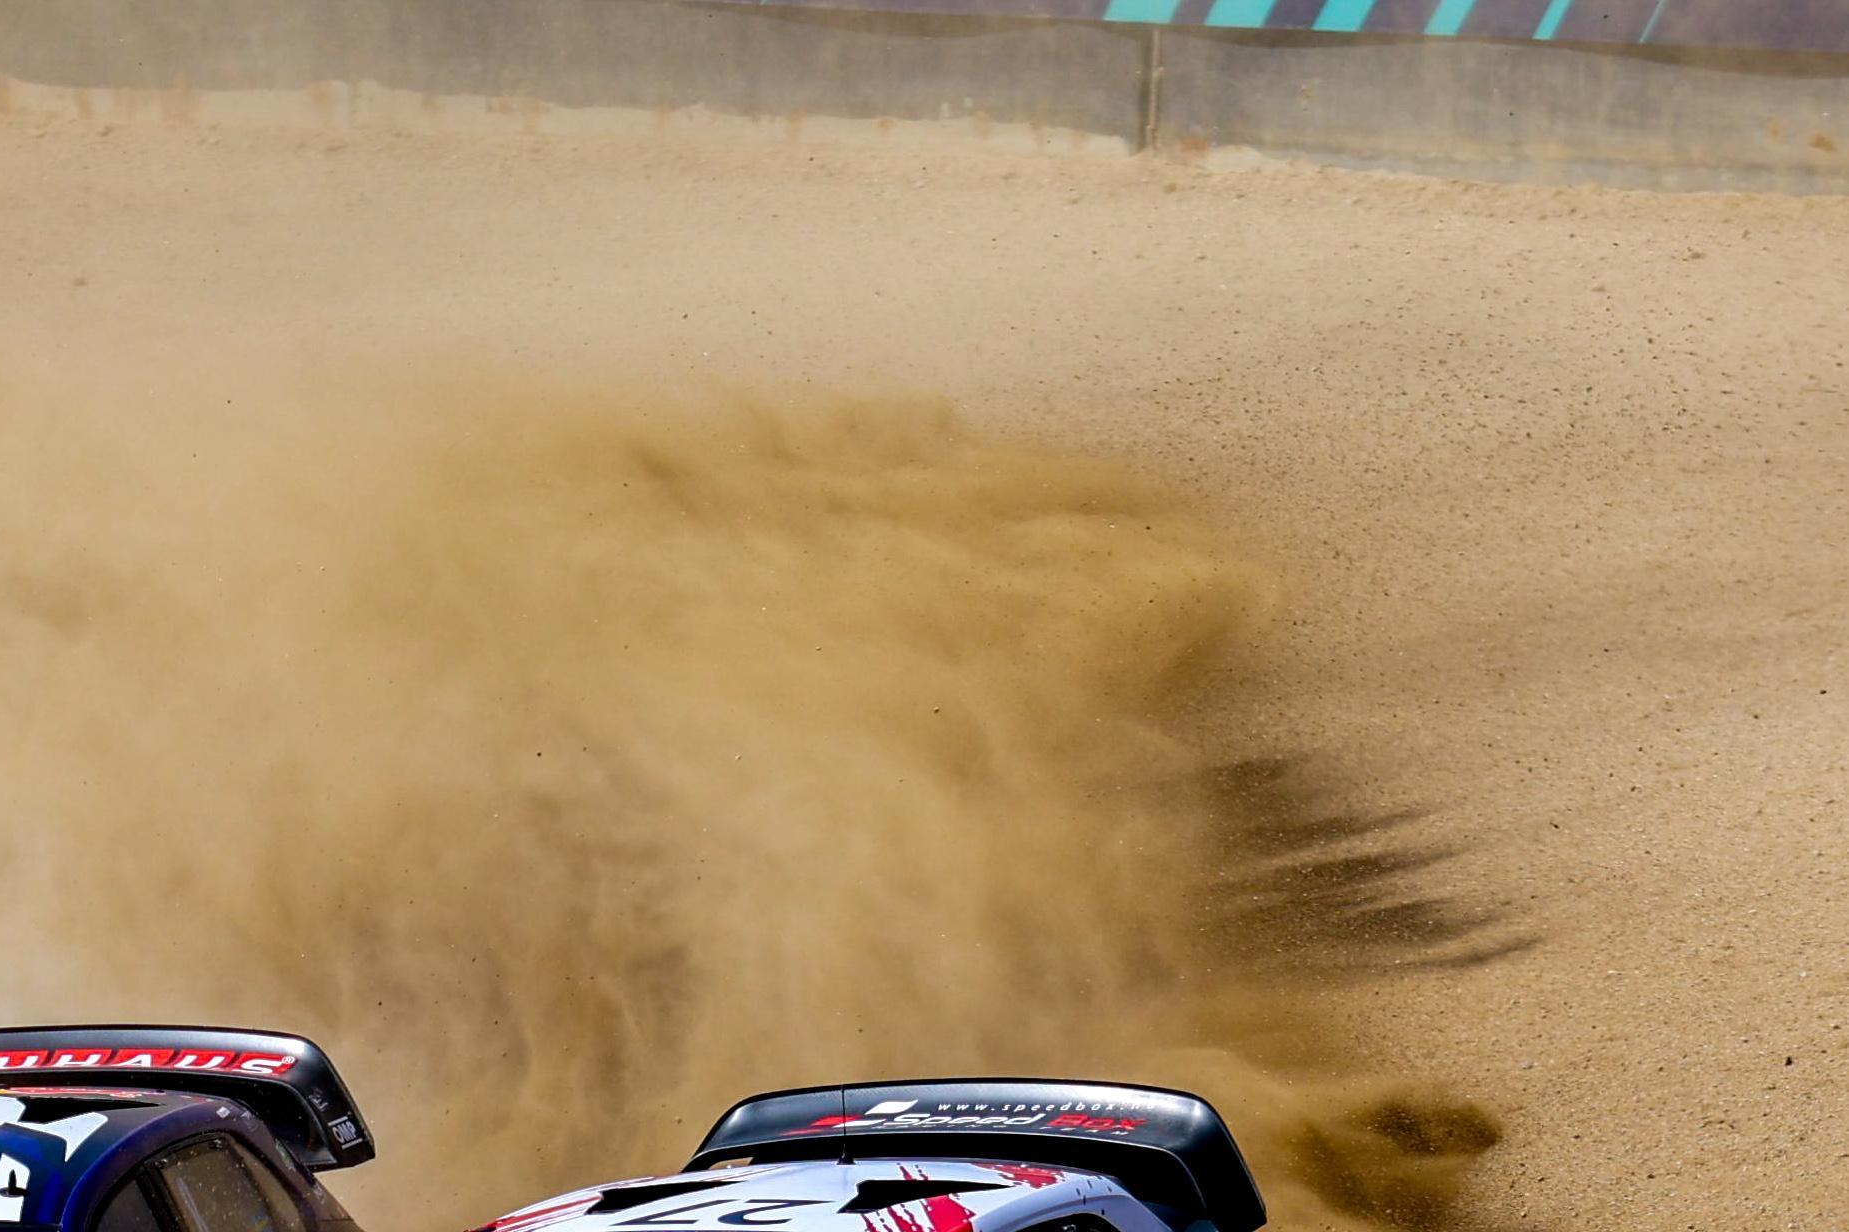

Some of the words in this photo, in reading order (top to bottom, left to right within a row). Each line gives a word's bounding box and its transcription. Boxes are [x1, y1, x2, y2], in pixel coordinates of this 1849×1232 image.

[330, 1120, 358, 1144] OMP
[883, 1112, 1047, 1126] Speed
[1046, 1113, 1148, 1131] Box
[609, 1199, 836, 1226] 27
